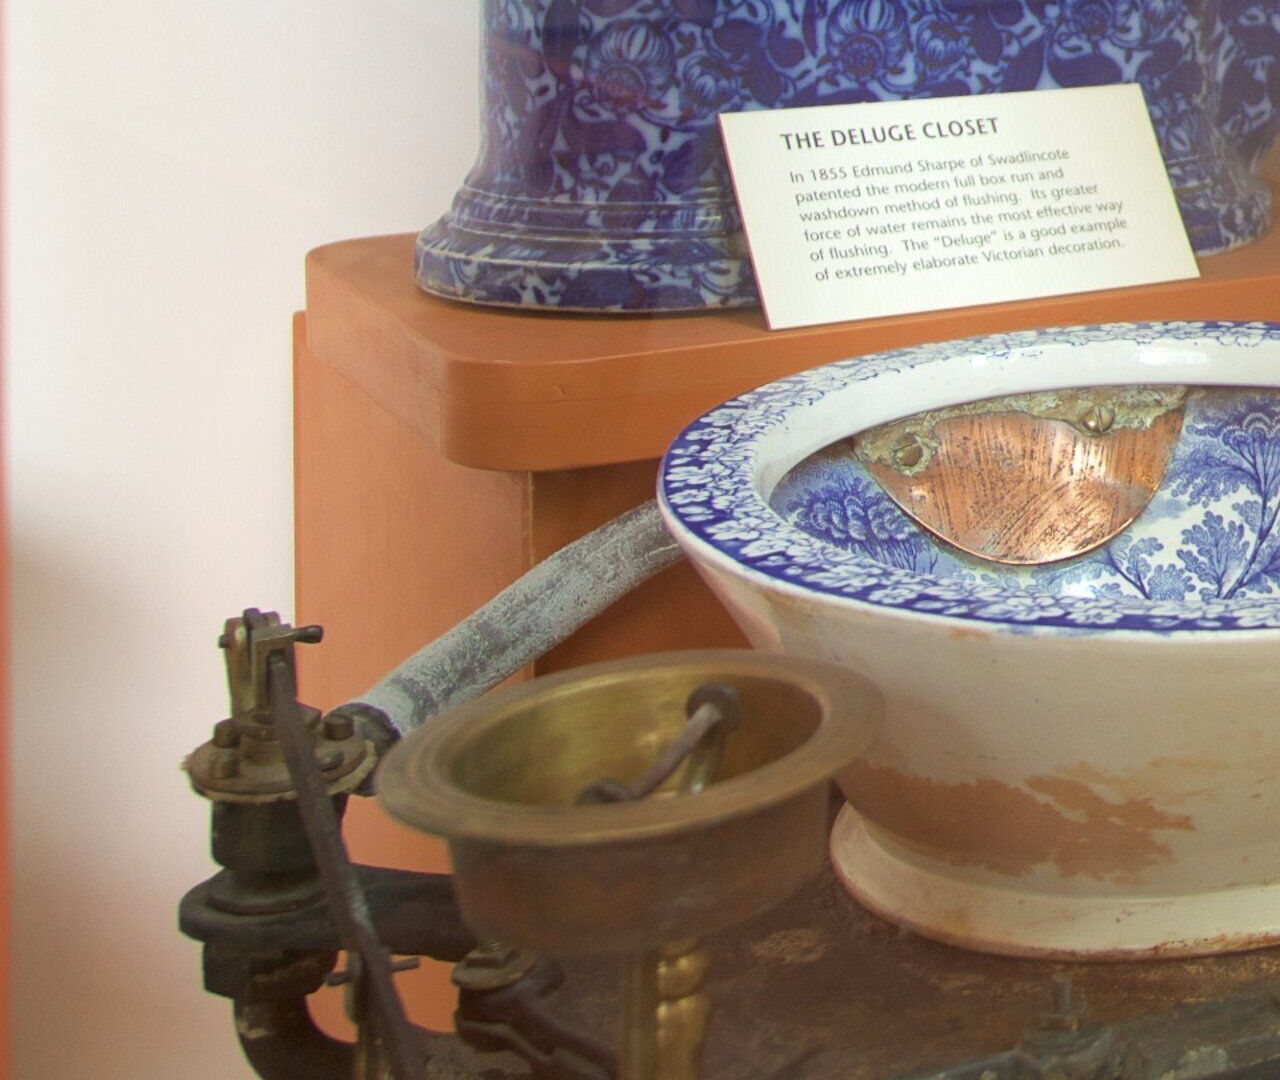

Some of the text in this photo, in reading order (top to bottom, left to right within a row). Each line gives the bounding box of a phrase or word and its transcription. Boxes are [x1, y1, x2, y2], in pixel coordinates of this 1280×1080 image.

[781, 117, 999, 150] THE DELUGE CLOSET
[790, 149, 1070, 184] In 1855 Edmund Sharpe of Swadlincote
[795, 166, 1065, 206] patented the modern full box run and
[799, 183, 1099, 223] washdown method of flushing. Its greater
[804, 199, 1123, 243] force of water remains the most effective way
[810, 248, 824, 263] of
[829, 242, 893, 261] flushing.
[901, 238, 929, 253] The
[1003, 229, 1014, 242] is
[1019, 230, 1027, 241] a
[1030, 223, 1067, 242] good
[1070, 217, 1128, 235] example
[815, 237, 1126, 283] of extremely elaborate Victorian decoration.
